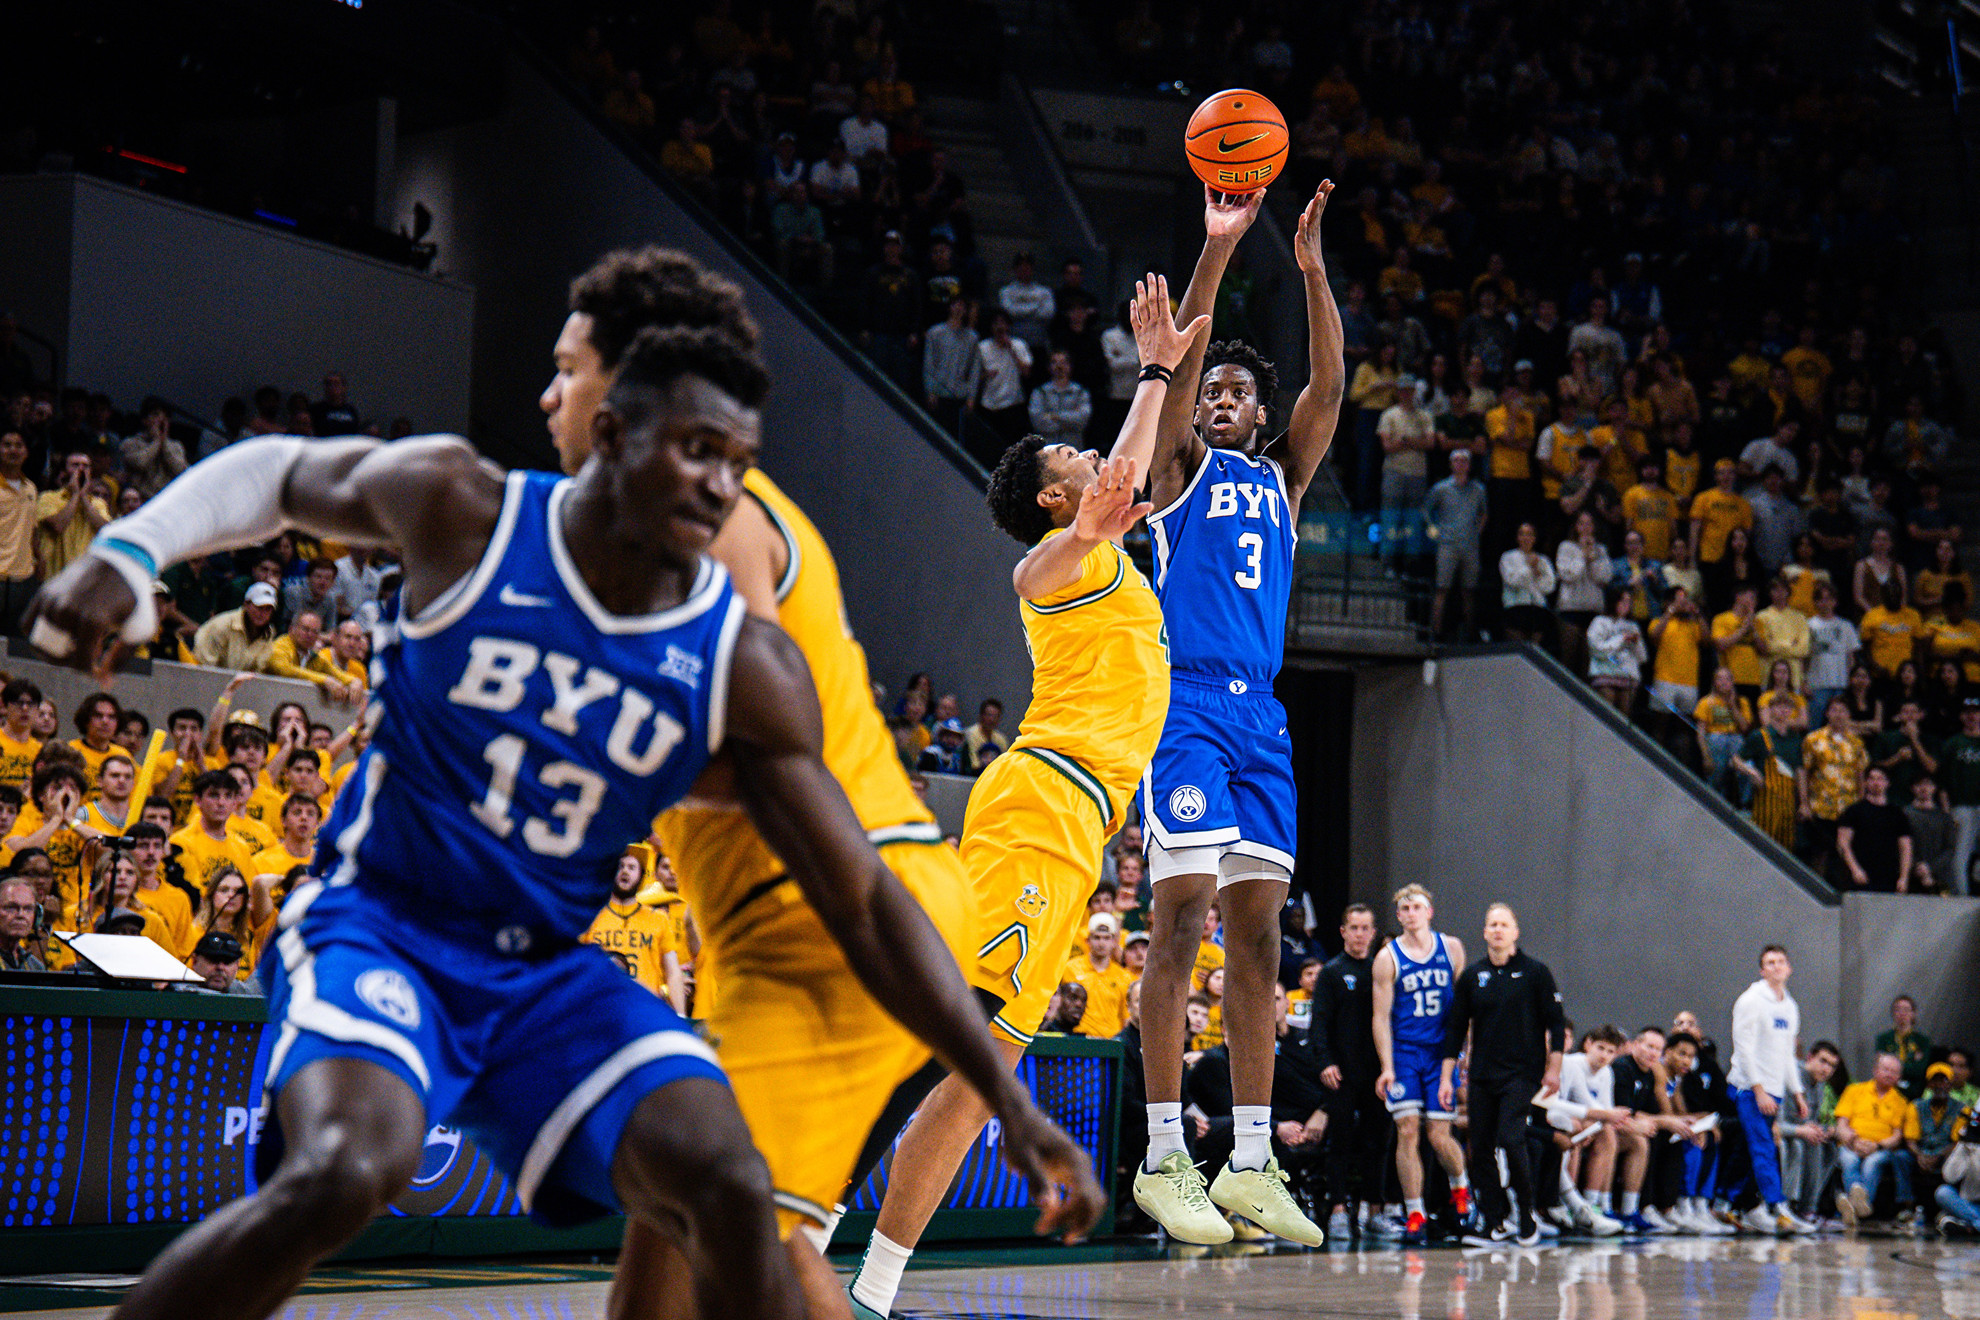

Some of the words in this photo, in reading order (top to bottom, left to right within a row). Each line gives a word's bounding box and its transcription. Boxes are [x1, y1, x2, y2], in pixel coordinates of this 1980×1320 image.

[1218, 162, 1273, 183] ELITE
[1206, 481, 1280, 529] BYU
[1234, 531, 1264, 590] 3
[448, 635, 686, 778] BYU
[468, 732, 609, 859] 13
[592, 930, 623, 947] SIC
[629, 930, 653, 950] EM
[1402, 968, 1449, 992] BYU
[1413, 989, 1441, 1017] 15
